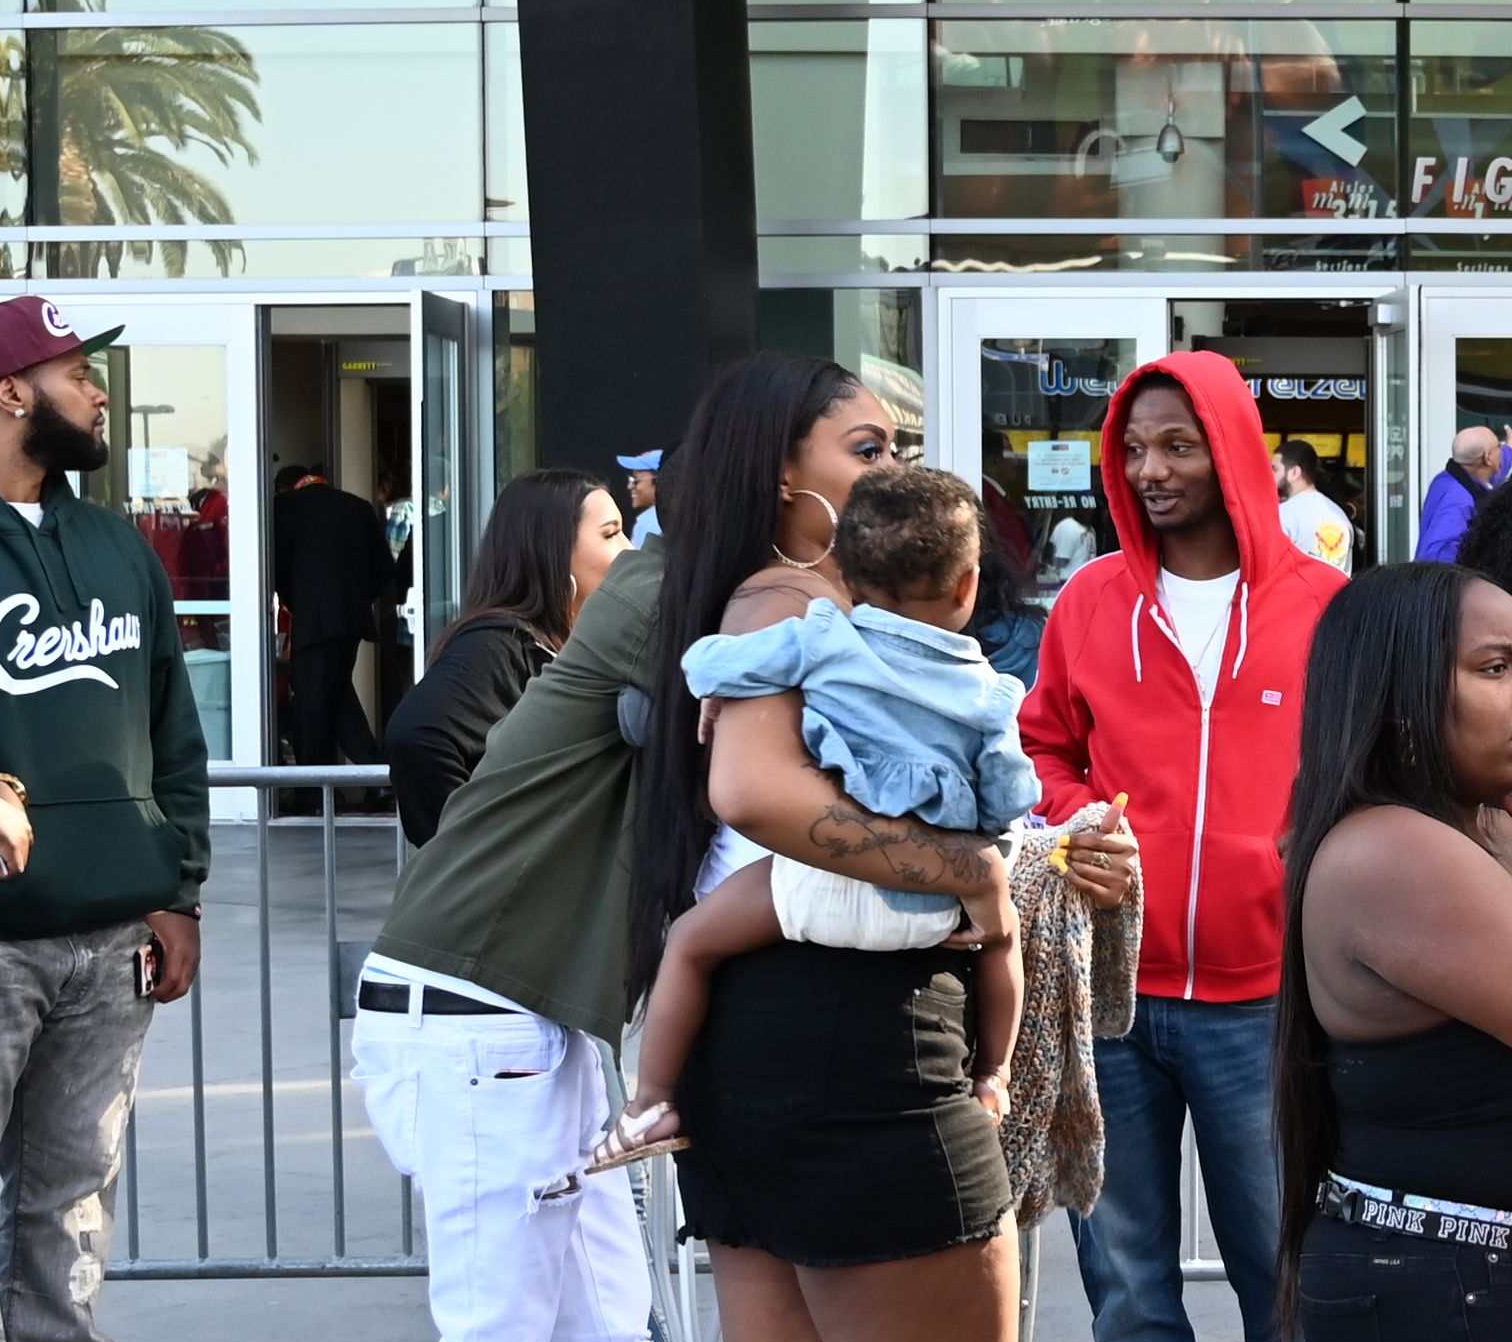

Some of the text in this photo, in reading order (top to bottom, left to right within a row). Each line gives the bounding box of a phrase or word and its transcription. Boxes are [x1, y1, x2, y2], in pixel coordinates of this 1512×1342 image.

[1330, 180, 1375, 194] Aisles
[1362, 1198, 1427, 1234] PINK
[1437, 1216, 1511, 1250] PINK
